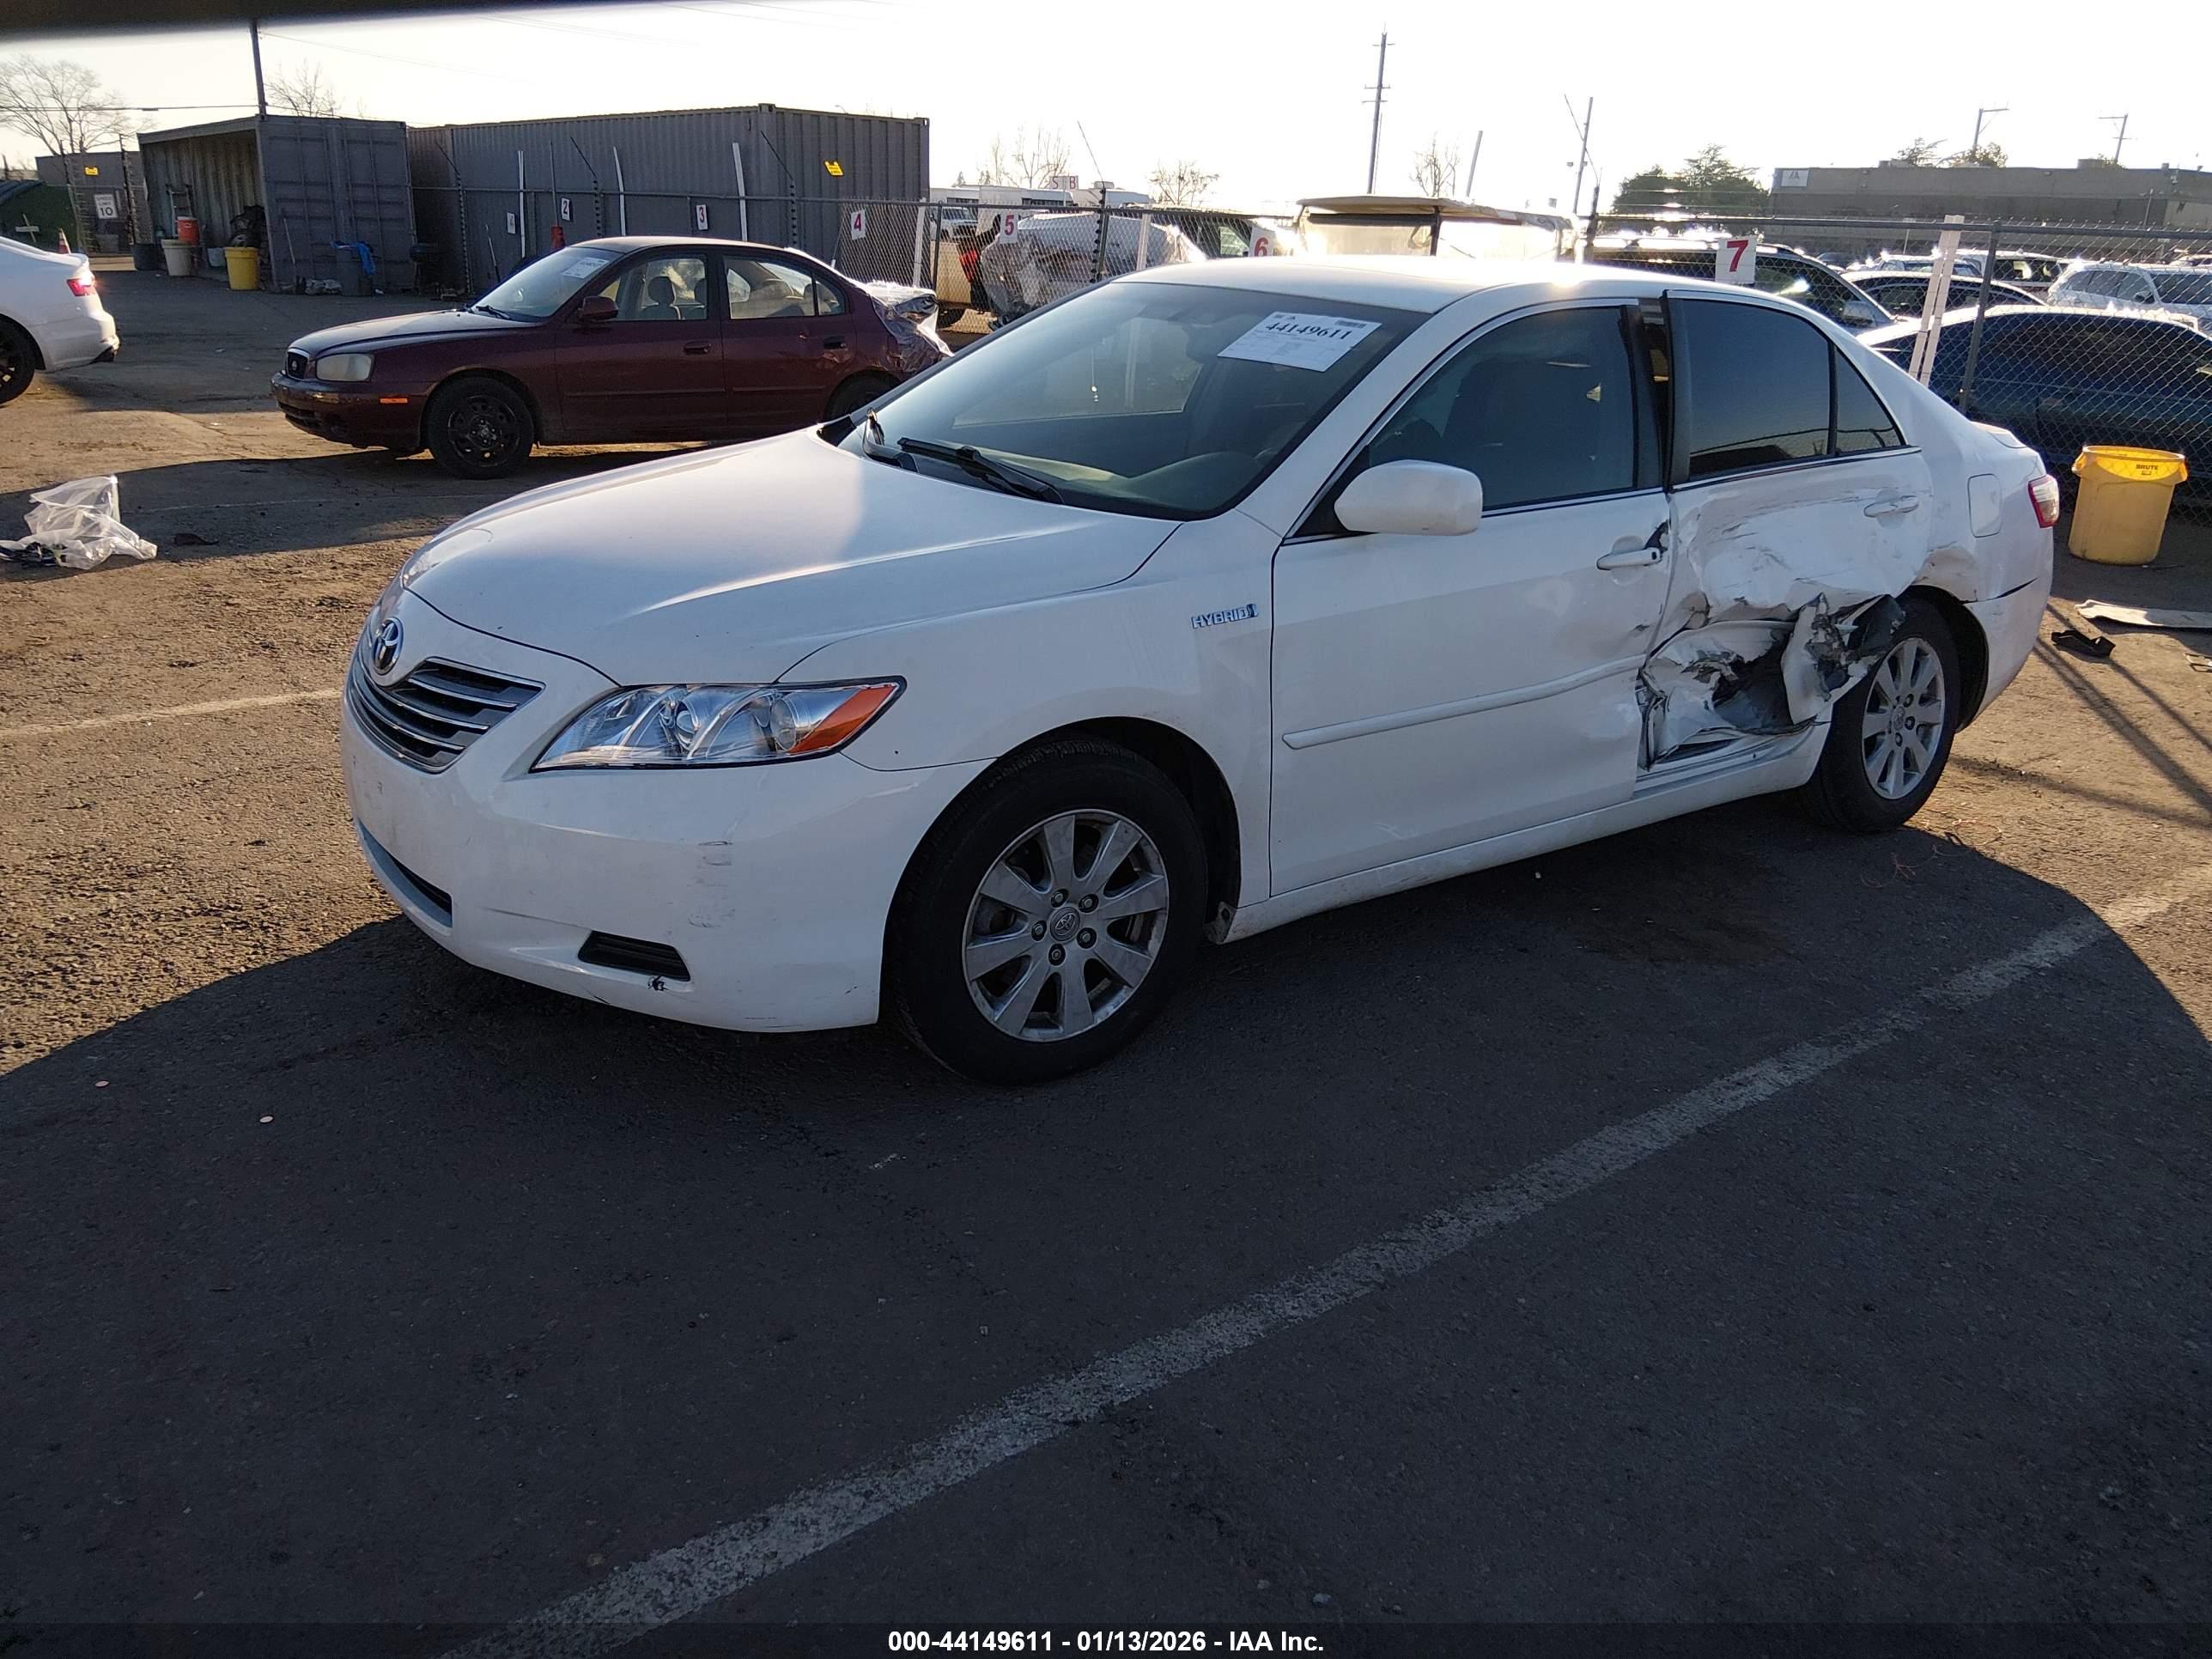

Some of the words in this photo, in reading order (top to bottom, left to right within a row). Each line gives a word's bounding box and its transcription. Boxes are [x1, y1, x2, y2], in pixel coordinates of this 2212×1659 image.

[100, 207, 113, 216] 10
[562, 200, 568, 215] 2
[699, 206, 705, 223] 3
[854, 213, 862, 232] 4
[1004, 215, 1014, 236] 5
[1254, 237, 1268, 257] 6
[1726, 240, 1749, 272] 7
[1265, 321, 1352, 340] 44149611
[1191, 606, 1249, 629] HYBRID
